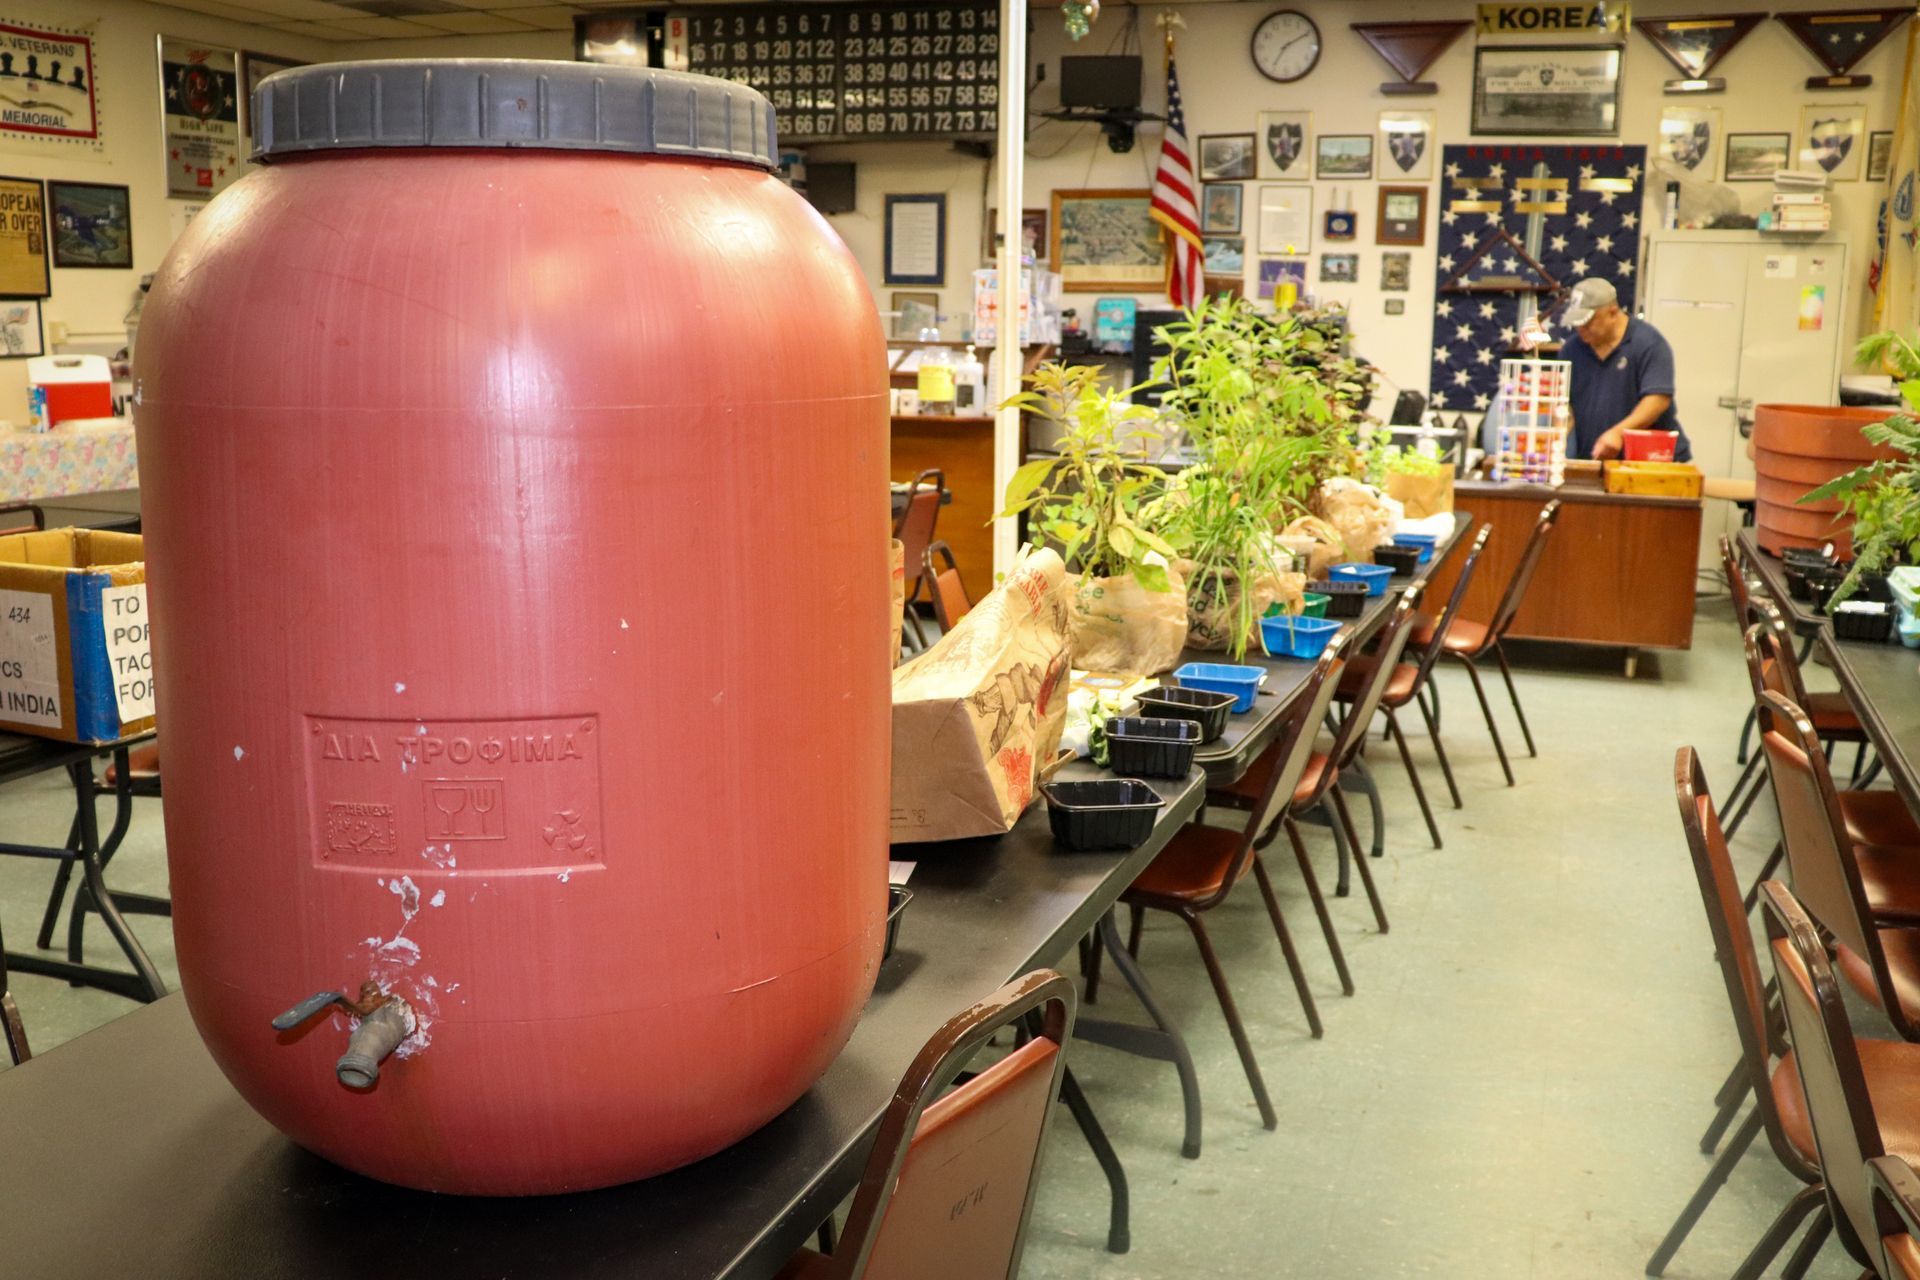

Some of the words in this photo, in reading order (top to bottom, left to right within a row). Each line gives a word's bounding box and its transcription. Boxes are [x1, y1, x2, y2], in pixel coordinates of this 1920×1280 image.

[672, 20, 681, 37] B
[694, 20, 700, 36] 1
[714, 18, 723, 36] 2
[735, 17, 744, 35] 3
[755, 17, 765, 34] 4
[777, 16, 787, 34] 5
[799, 15, 808, 33] 6
[821, 14, 831, 32] 7
[850, 13, 859, 32] 8
[871, 13, 881, 31] 9
[890, 12, 907, 31] 10
[914, 12, 928, 30] 11
[936, 11, 950, 29] 12
[959, 10, 975, 29] 13
[981, 9, 996, 28] 14
[1500, 6, 1607, 28] KOREA
[9, 37, 75, 57] VETERANS
[691, 43, 705, 62] 16
[711, 43, 726, 60] 17
[732, 42, 748, 60] 18
[754, 41, 768, 59] 19
[773, 40, 791, 59] 20
[796, 40, 812, 58] 21
[816, 39, 834, 58] 22
[845, 38, 863, 57] 23
[867, 38, 885, 56] 24
[889, 37, 907, 56] 25
[911, 36, 930, 55] 26
[934, 36, 952, 54] 27
[957, 35, 975, 54] 28
[979, 34, 998, 53] 29
[731, 66, 749, 85] 33
[752, 66, 770, 85] 34
[773, 65, 791, 84] 35
[795, 64, 813, 84] 36
[816, 64, 834, 83] 37
[845, 64, 863, 82] 38
[867, 63, 885, 82] 39
[889, 62, 907, 81] 40
[912, 61, 929, 80] 41
[934, 61, 952, 80] 42
[956, 60, 975, 80] 43
[978, 60, 997, 79] 44
[774, 90, 791, 109] 50
[796, 90, 813, 108] 51
[816, 89, 835, 108] 52
[844, 88, 864, 108] 53
[867, 88, 885, 107] 54
[889, 87, 907, 106] 55
[911, 87, 930, 106] 56
[934, 86, 952, 106] 57
[956, 86, 975, 105] 58
[978, 85, 998, 105] 59
[3, 110, 67, 128] MEMORIAL
[795, 114, 814, 133] 66
[816, 114, 835, 133] 67
[845, 114, 863, 132] 68
[867, 113, 885, 132] 69
[889, 113, 907, 131] 70
[912, 113, 929, 131] 71
[934, 112, 952, 131] 72
[956, 111, 975, 130] 73
[980, 111, 997, 130] 74
[12, 214, 41, 231] OVER
[9, 607, 30, 623] 434
[112, 596, 140, 616] TO
[0, 661, 22, 679] CS
[8, 692, 58, 717] INDIA
[322, 734, 380, 762] ΔΙΑ
[396, 734, 583, 765] ΤΡΟΦΙΜΑ
